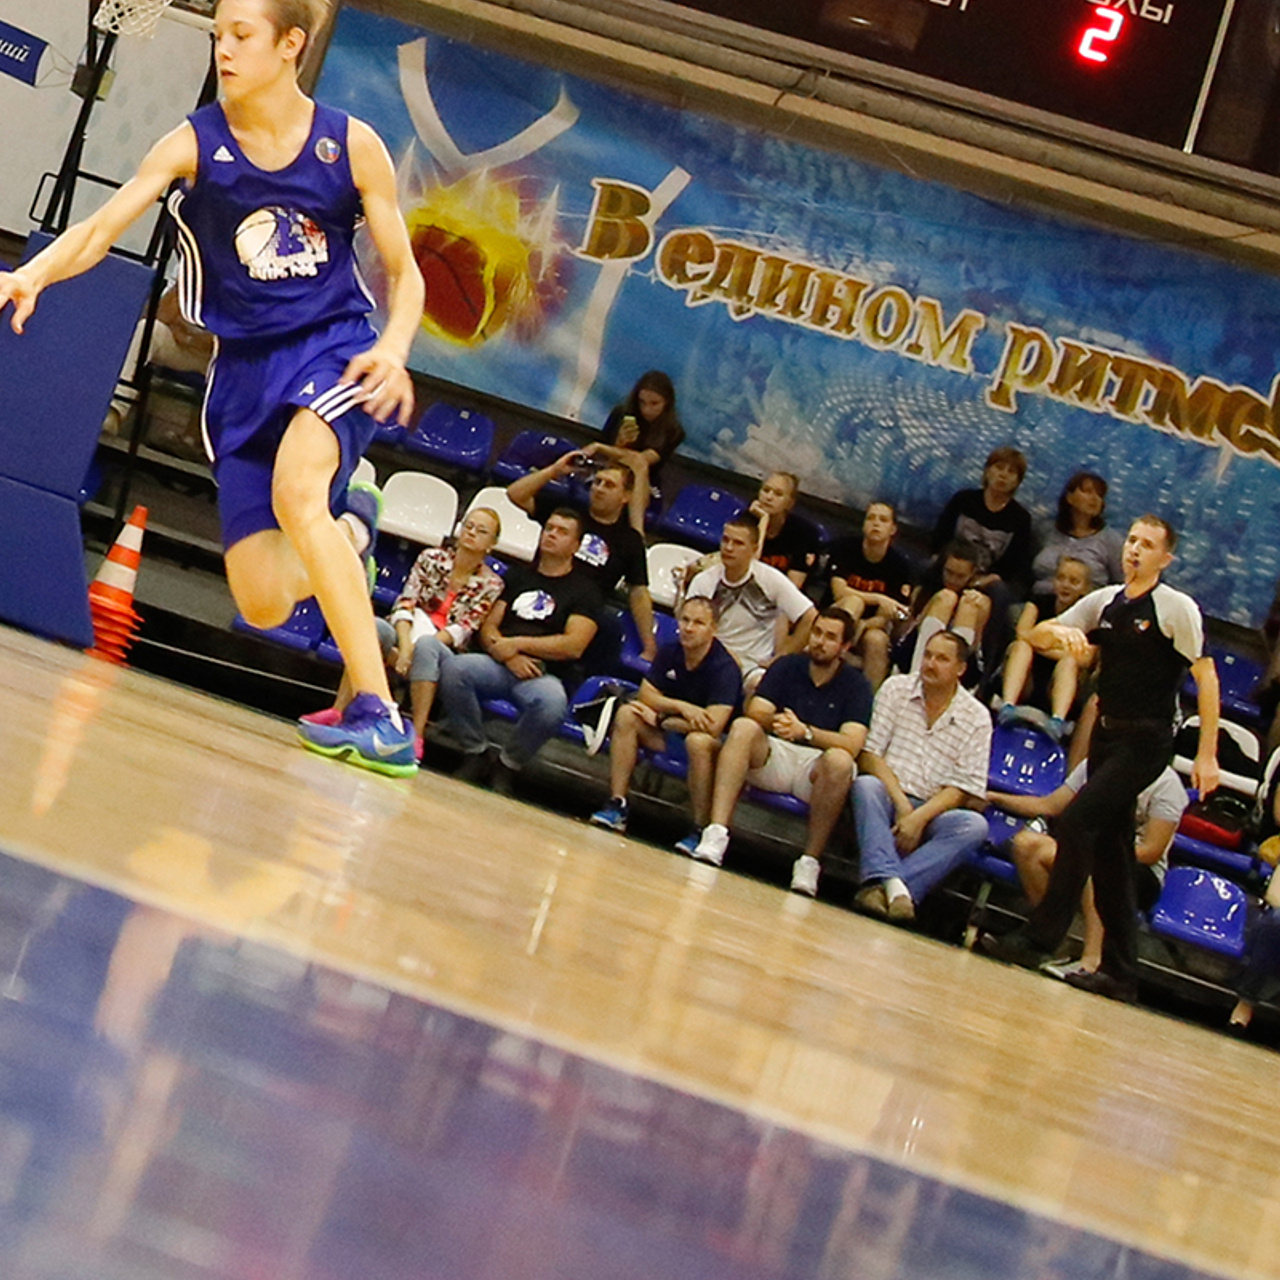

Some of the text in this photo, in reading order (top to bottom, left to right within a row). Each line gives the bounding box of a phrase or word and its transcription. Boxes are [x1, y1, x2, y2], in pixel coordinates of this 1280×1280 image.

[1078, 7, 1124, 62] 2
[577, 176, 1280, 468] В едином ритме
